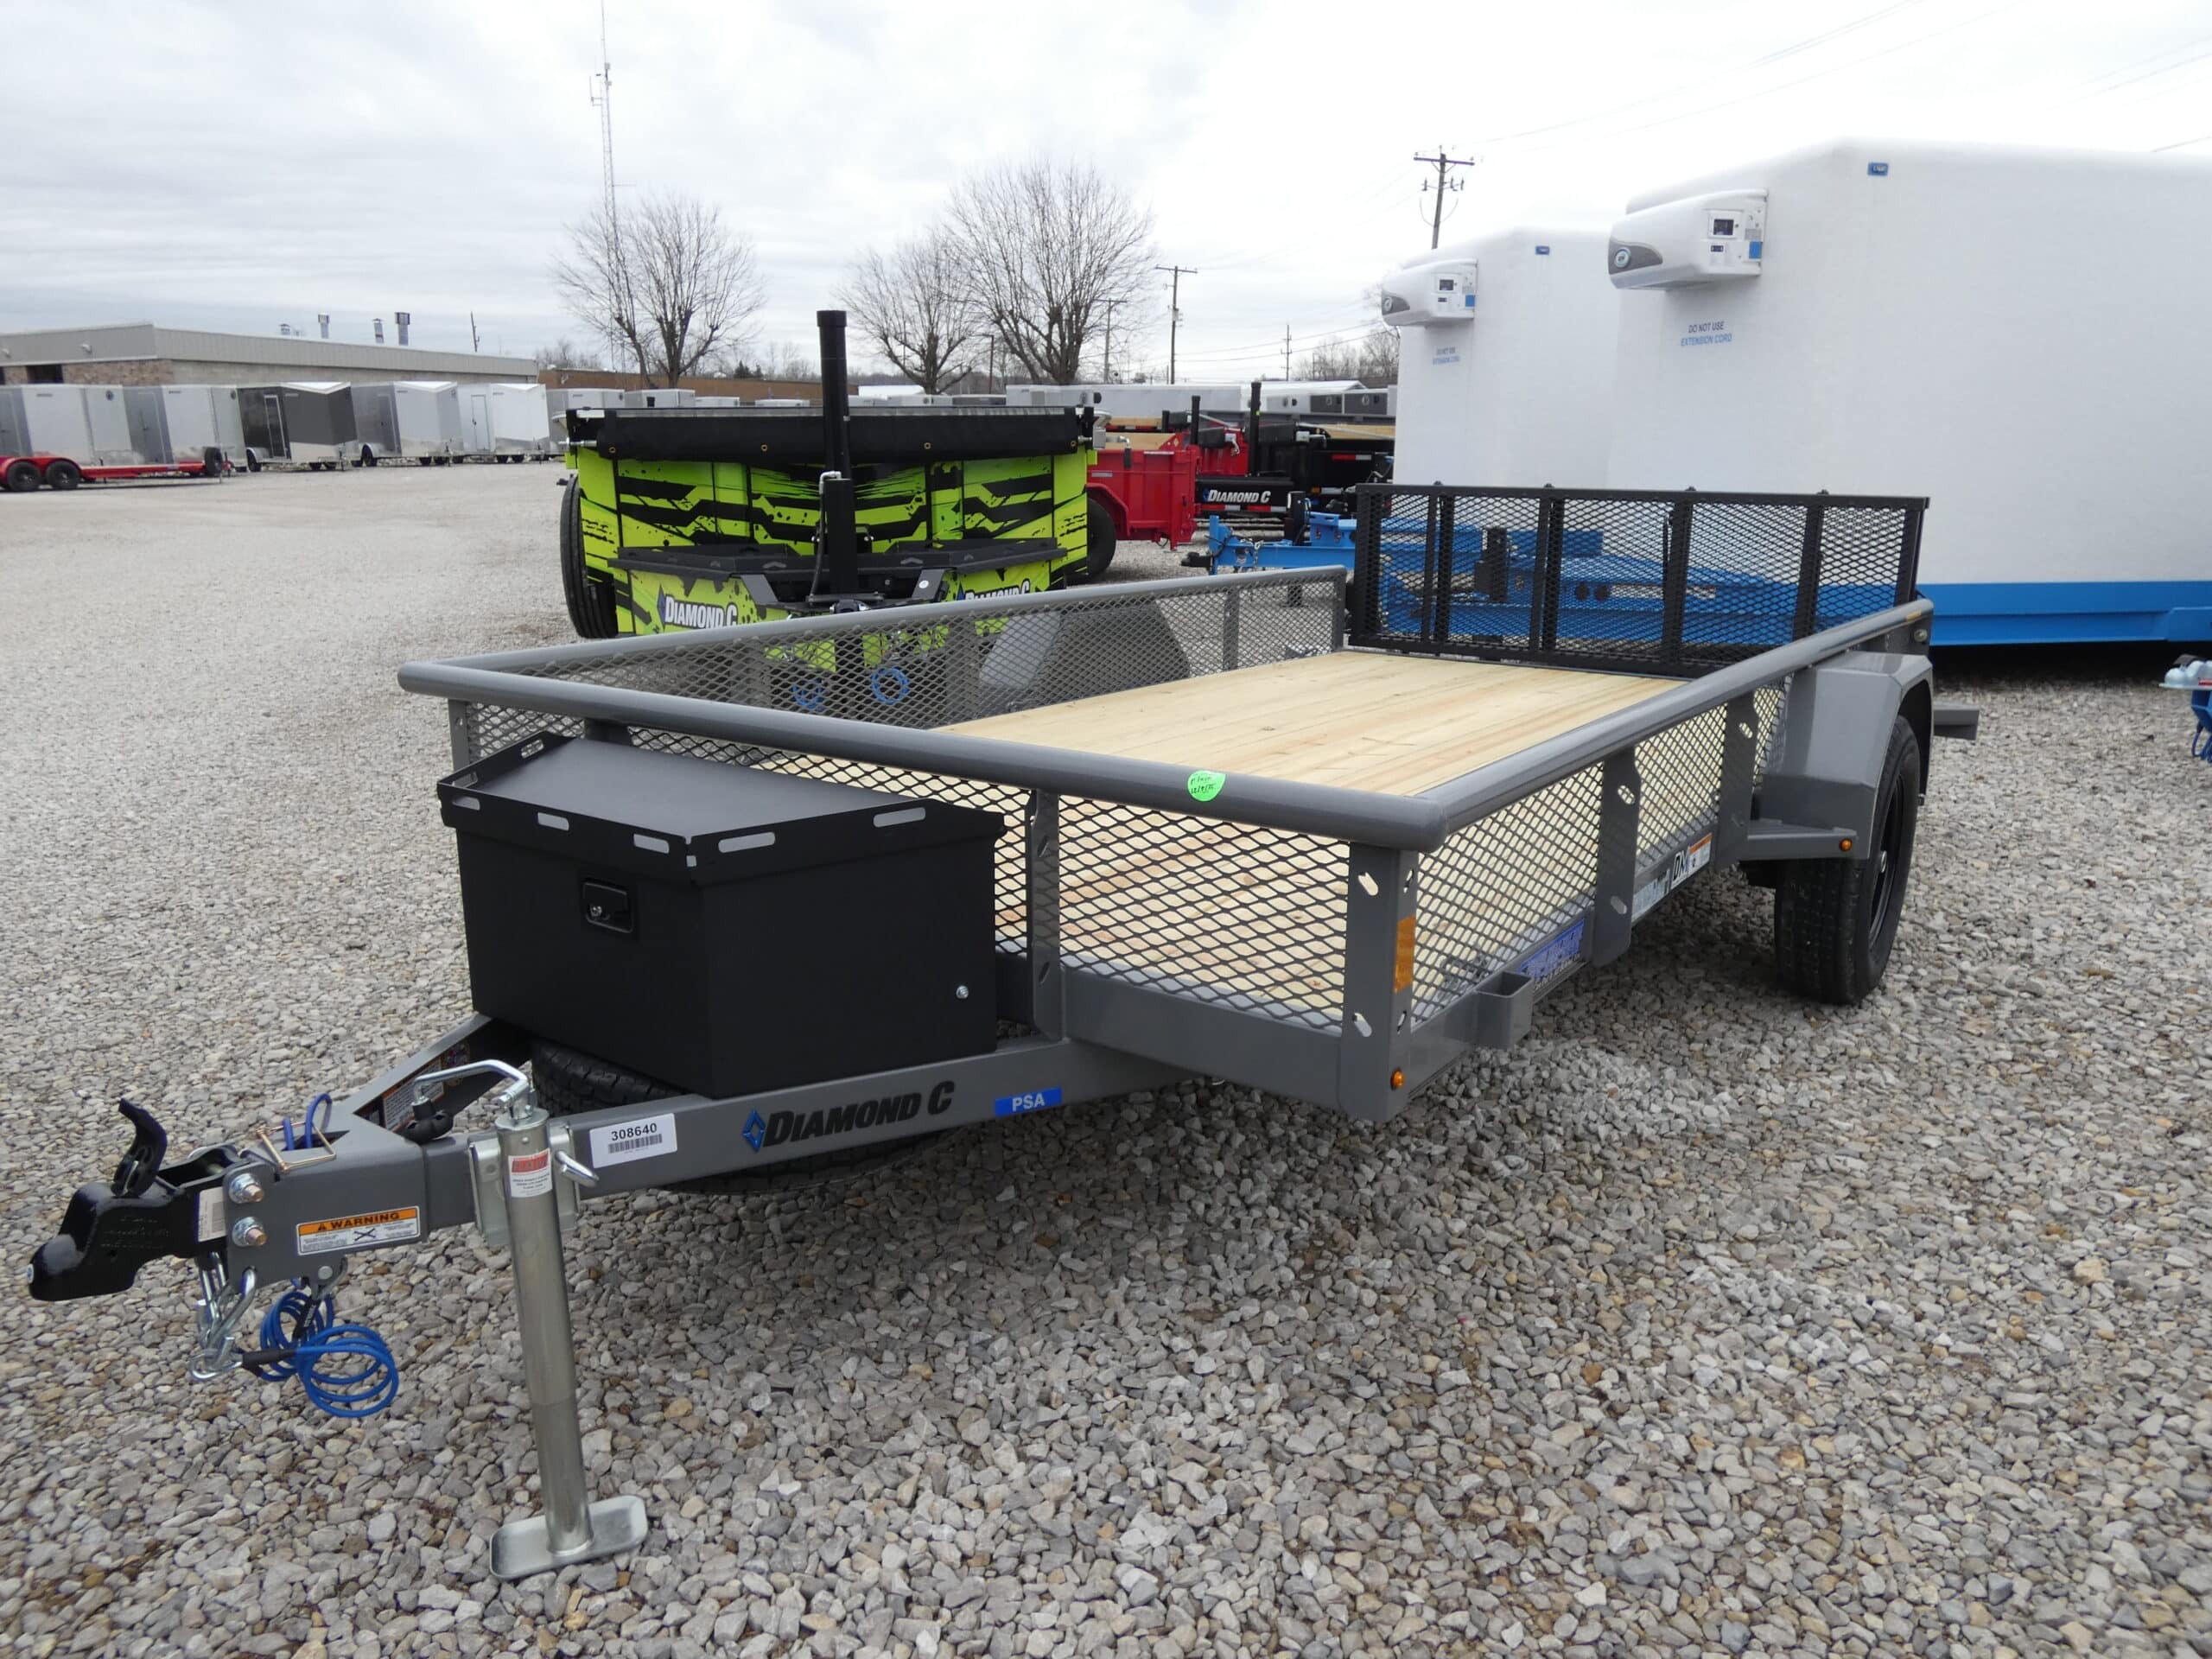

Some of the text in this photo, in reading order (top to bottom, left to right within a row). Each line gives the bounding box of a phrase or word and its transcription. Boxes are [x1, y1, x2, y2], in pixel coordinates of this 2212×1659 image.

[1688, 321, 1725, 334] DO NOT USE
[1207, 489, 1272, 504] DIAMOND C
[665, 595, 738, 629] DIAMOND C
[1012, 1092, 1046, 1112] PSA
[762, 1080, 955, 1147] DIAMOND C
[611, 1122, 658, 1141] 308640
[330, 1212, 400, 1230] WARNING
